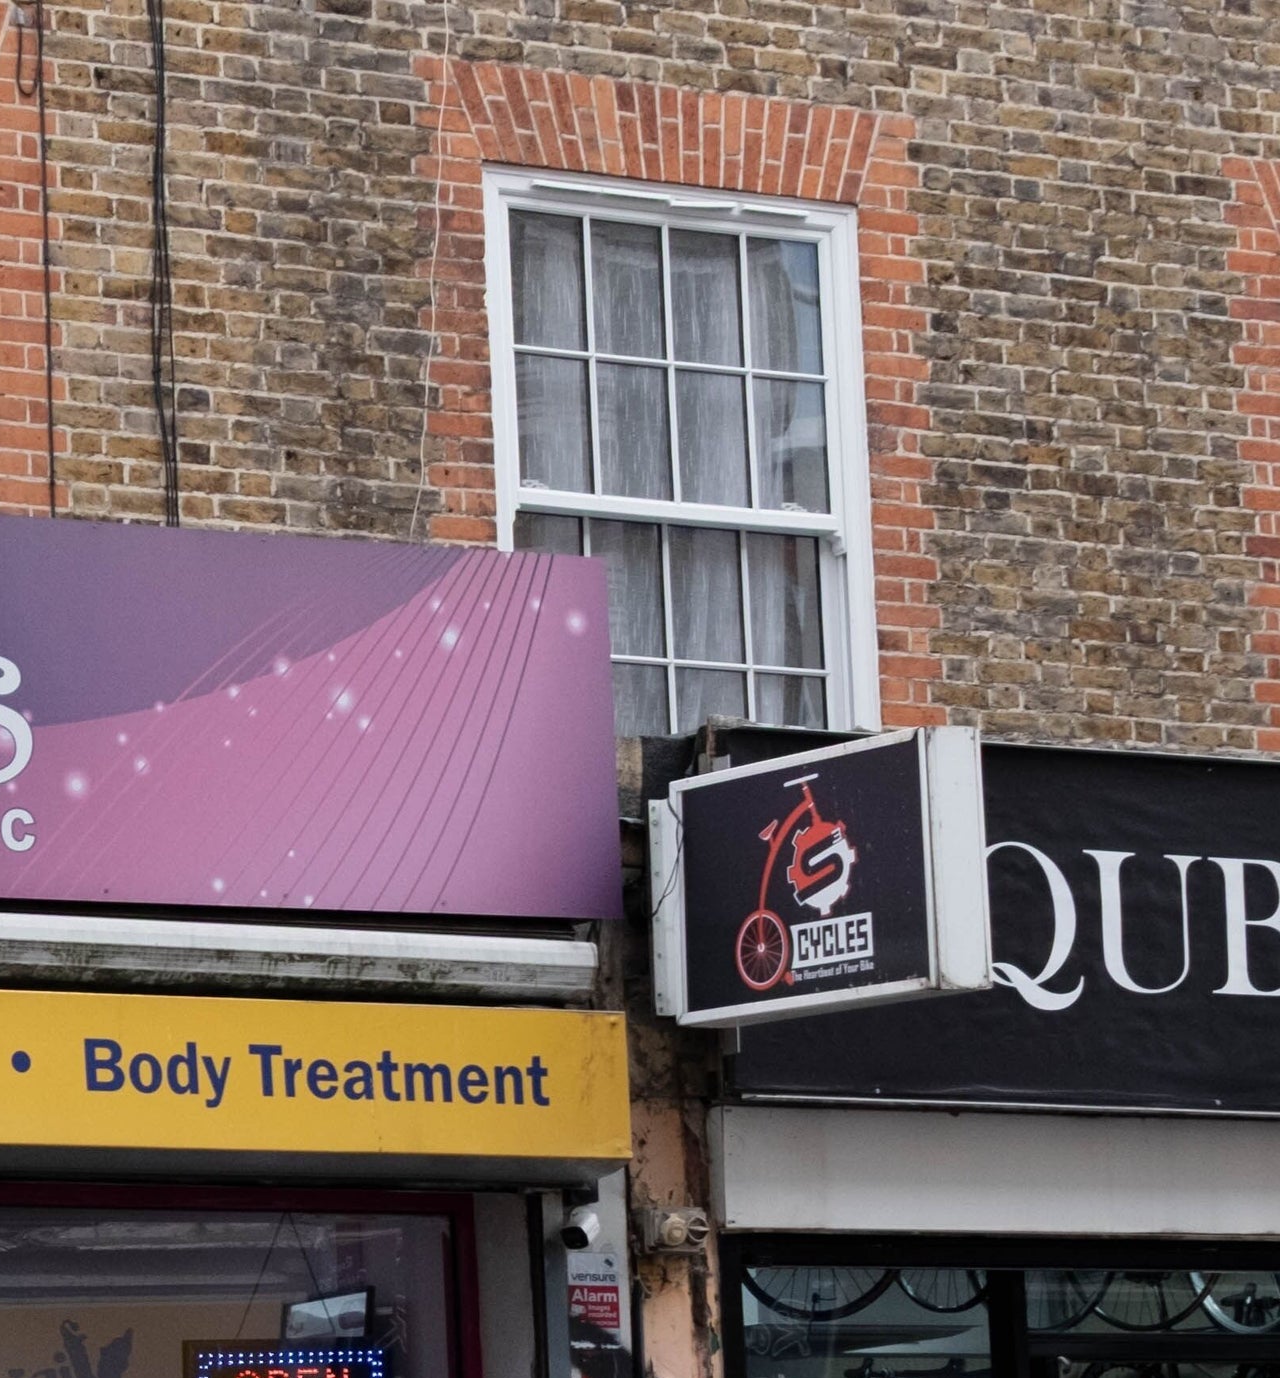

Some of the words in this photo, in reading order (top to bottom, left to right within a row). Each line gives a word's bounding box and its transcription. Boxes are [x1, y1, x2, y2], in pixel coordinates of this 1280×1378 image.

[797, 918, 868, 962] CYCLES
[84, 1037, 231, 1110] Body
[248, 1043, 551, 1108] Treatment
[572, 1288, 617, 1303] Alarm
